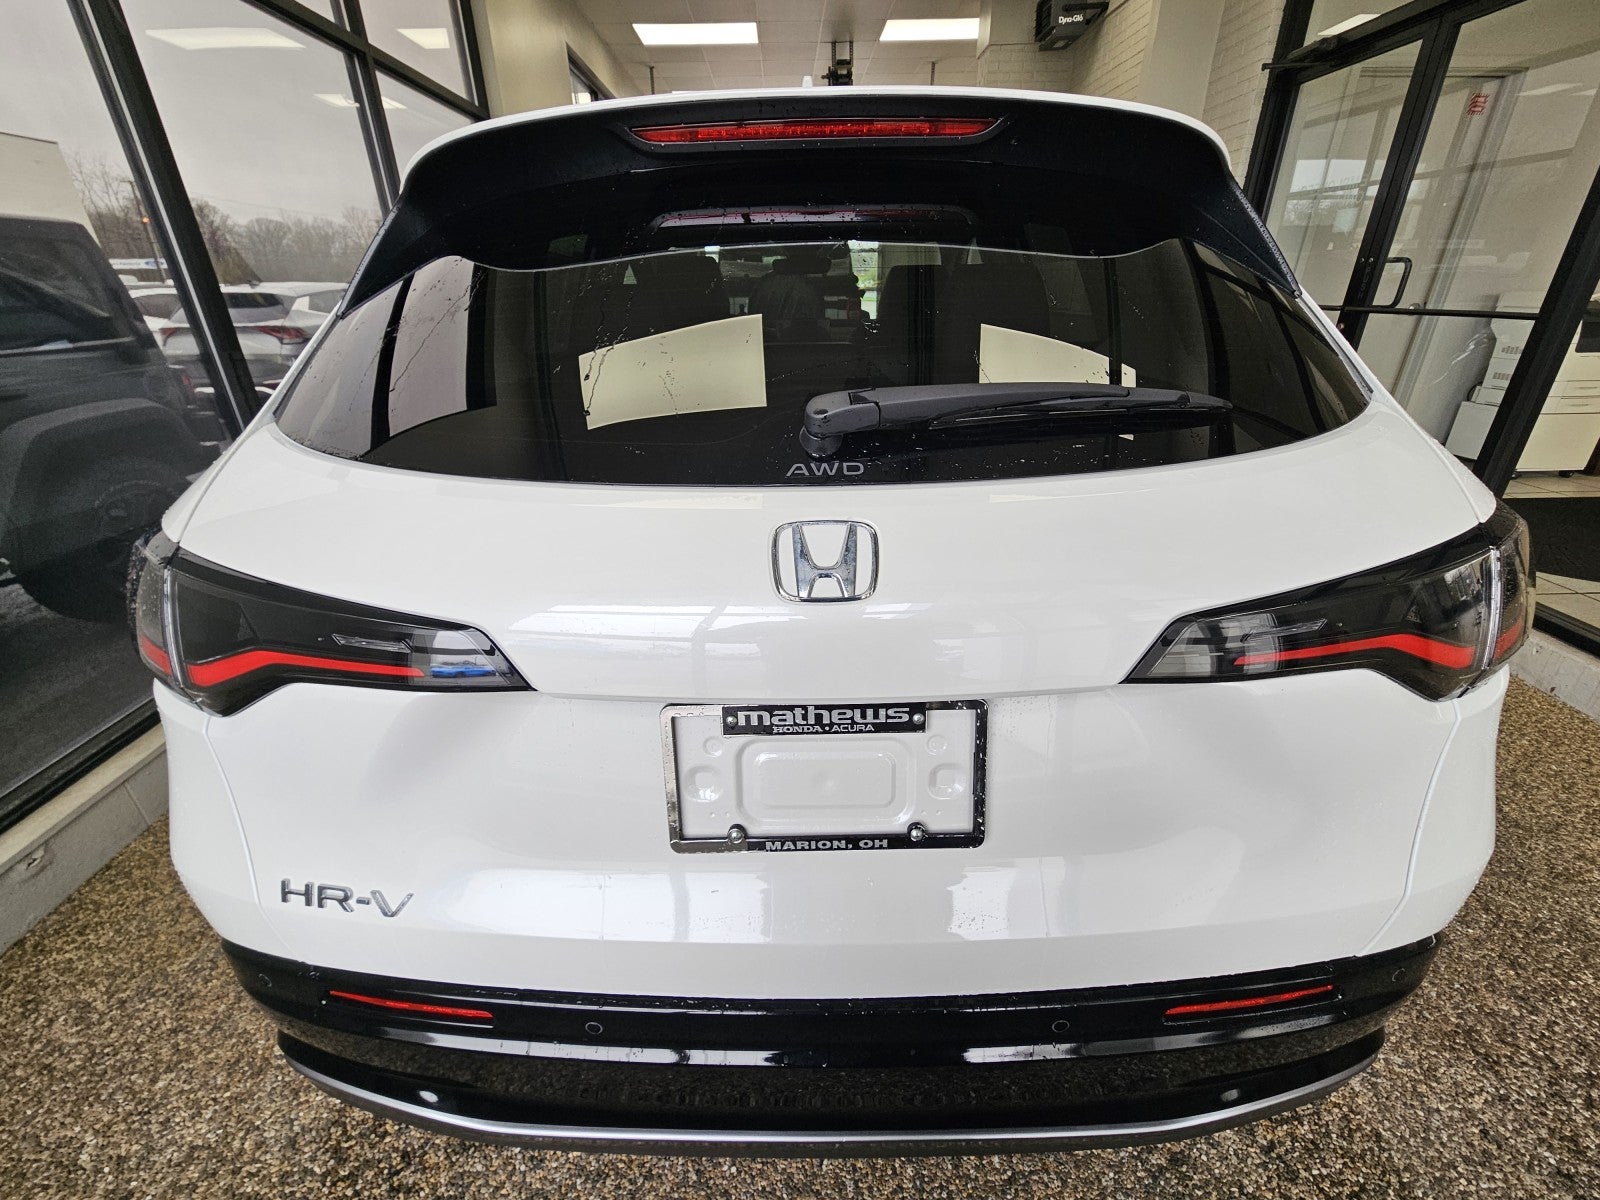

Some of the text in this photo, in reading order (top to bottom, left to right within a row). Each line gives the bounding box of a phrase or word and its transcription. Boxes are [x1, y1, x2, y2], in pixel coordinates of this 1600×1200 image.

[785, 462, 865, 477] AWD
[736, 705, 910, 725] mathews
[772, 724, 874, 734] HONDA ACURA
[765, 839, 889, 851] MARION, OH
[280, 878, 415, 918] HR-V
